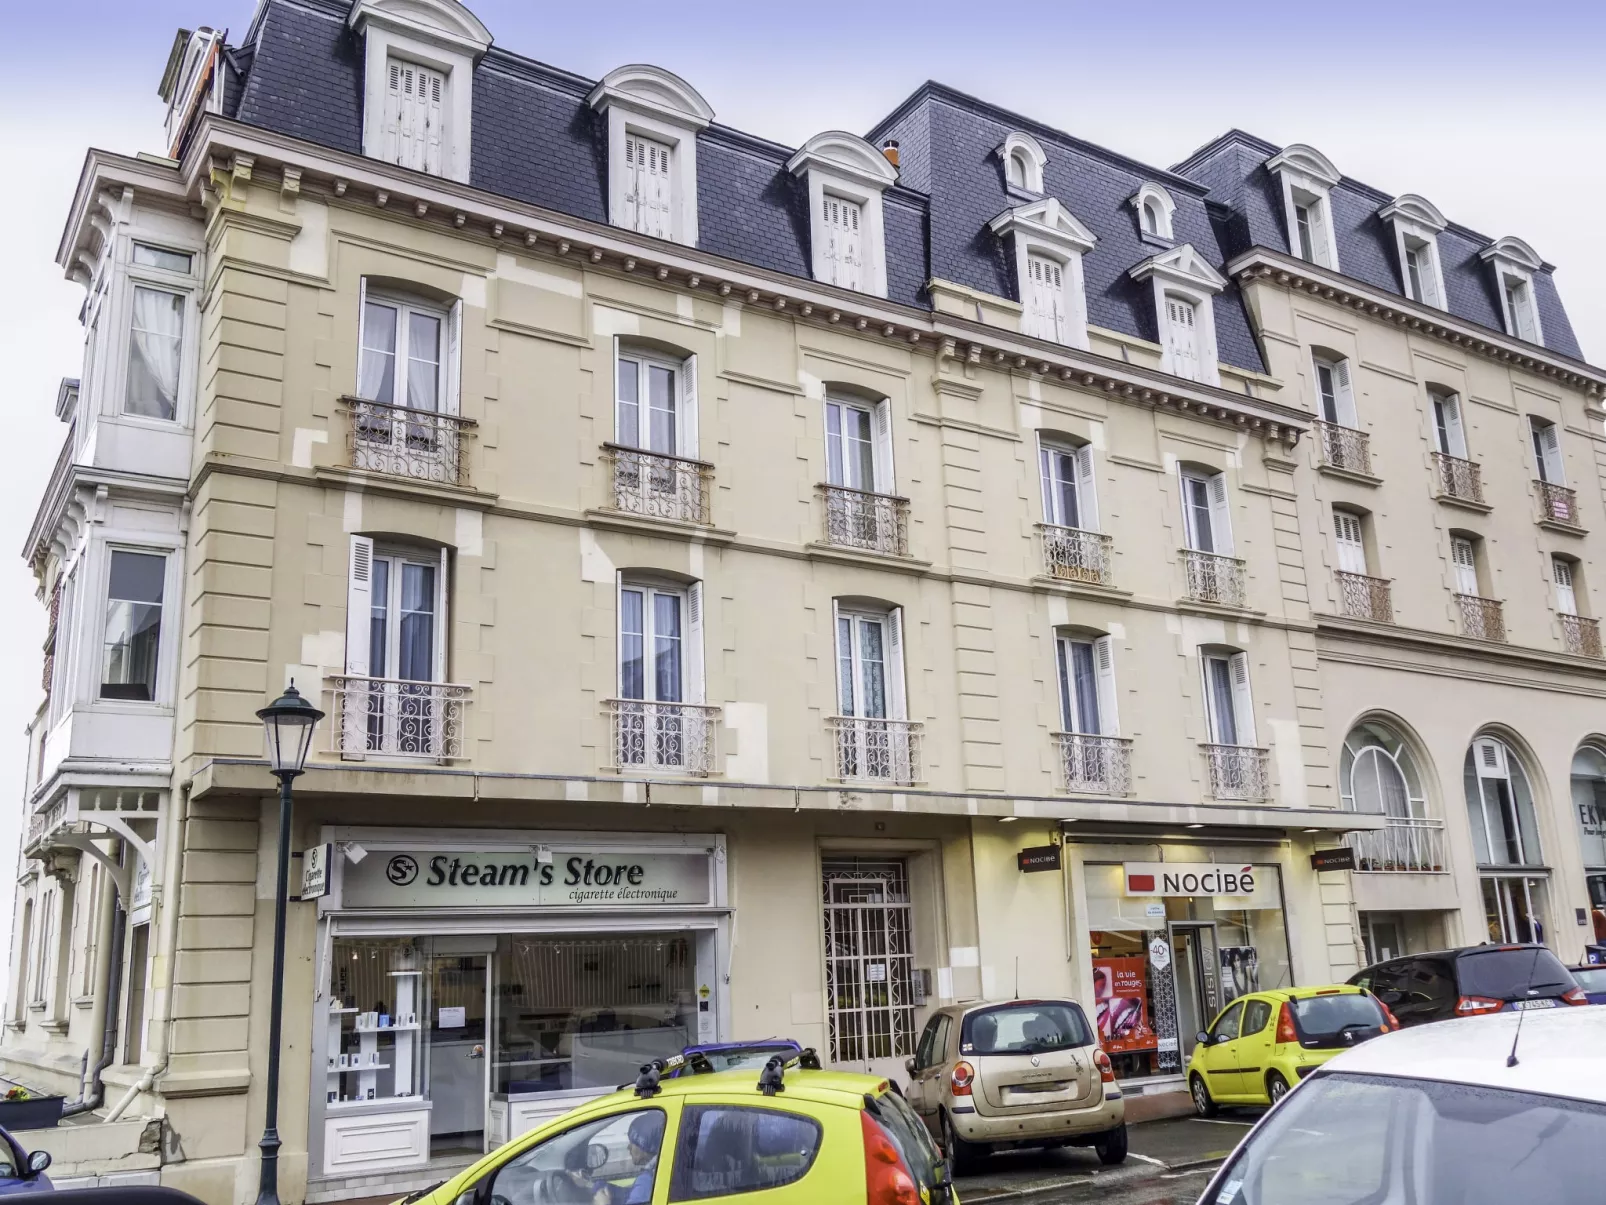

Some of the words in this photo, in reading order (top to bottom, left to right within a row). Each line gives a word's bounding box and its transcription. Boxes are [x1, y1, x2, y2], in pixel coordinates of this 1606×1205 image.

[427, 855, 553, 886] Steam's
[564, 857, 644, 886] Store
[569, 888, 614, 903] cigarette
[617, 887, 678, 903] électronique
[1589, 954, 1597, 964] P
[1116, 971, 1124, 979] la
[1126, 970, 1136, 978] vie
[1203, 947, 1216, 1008] sisley
[1121, 980, 1142, 988] rouges
